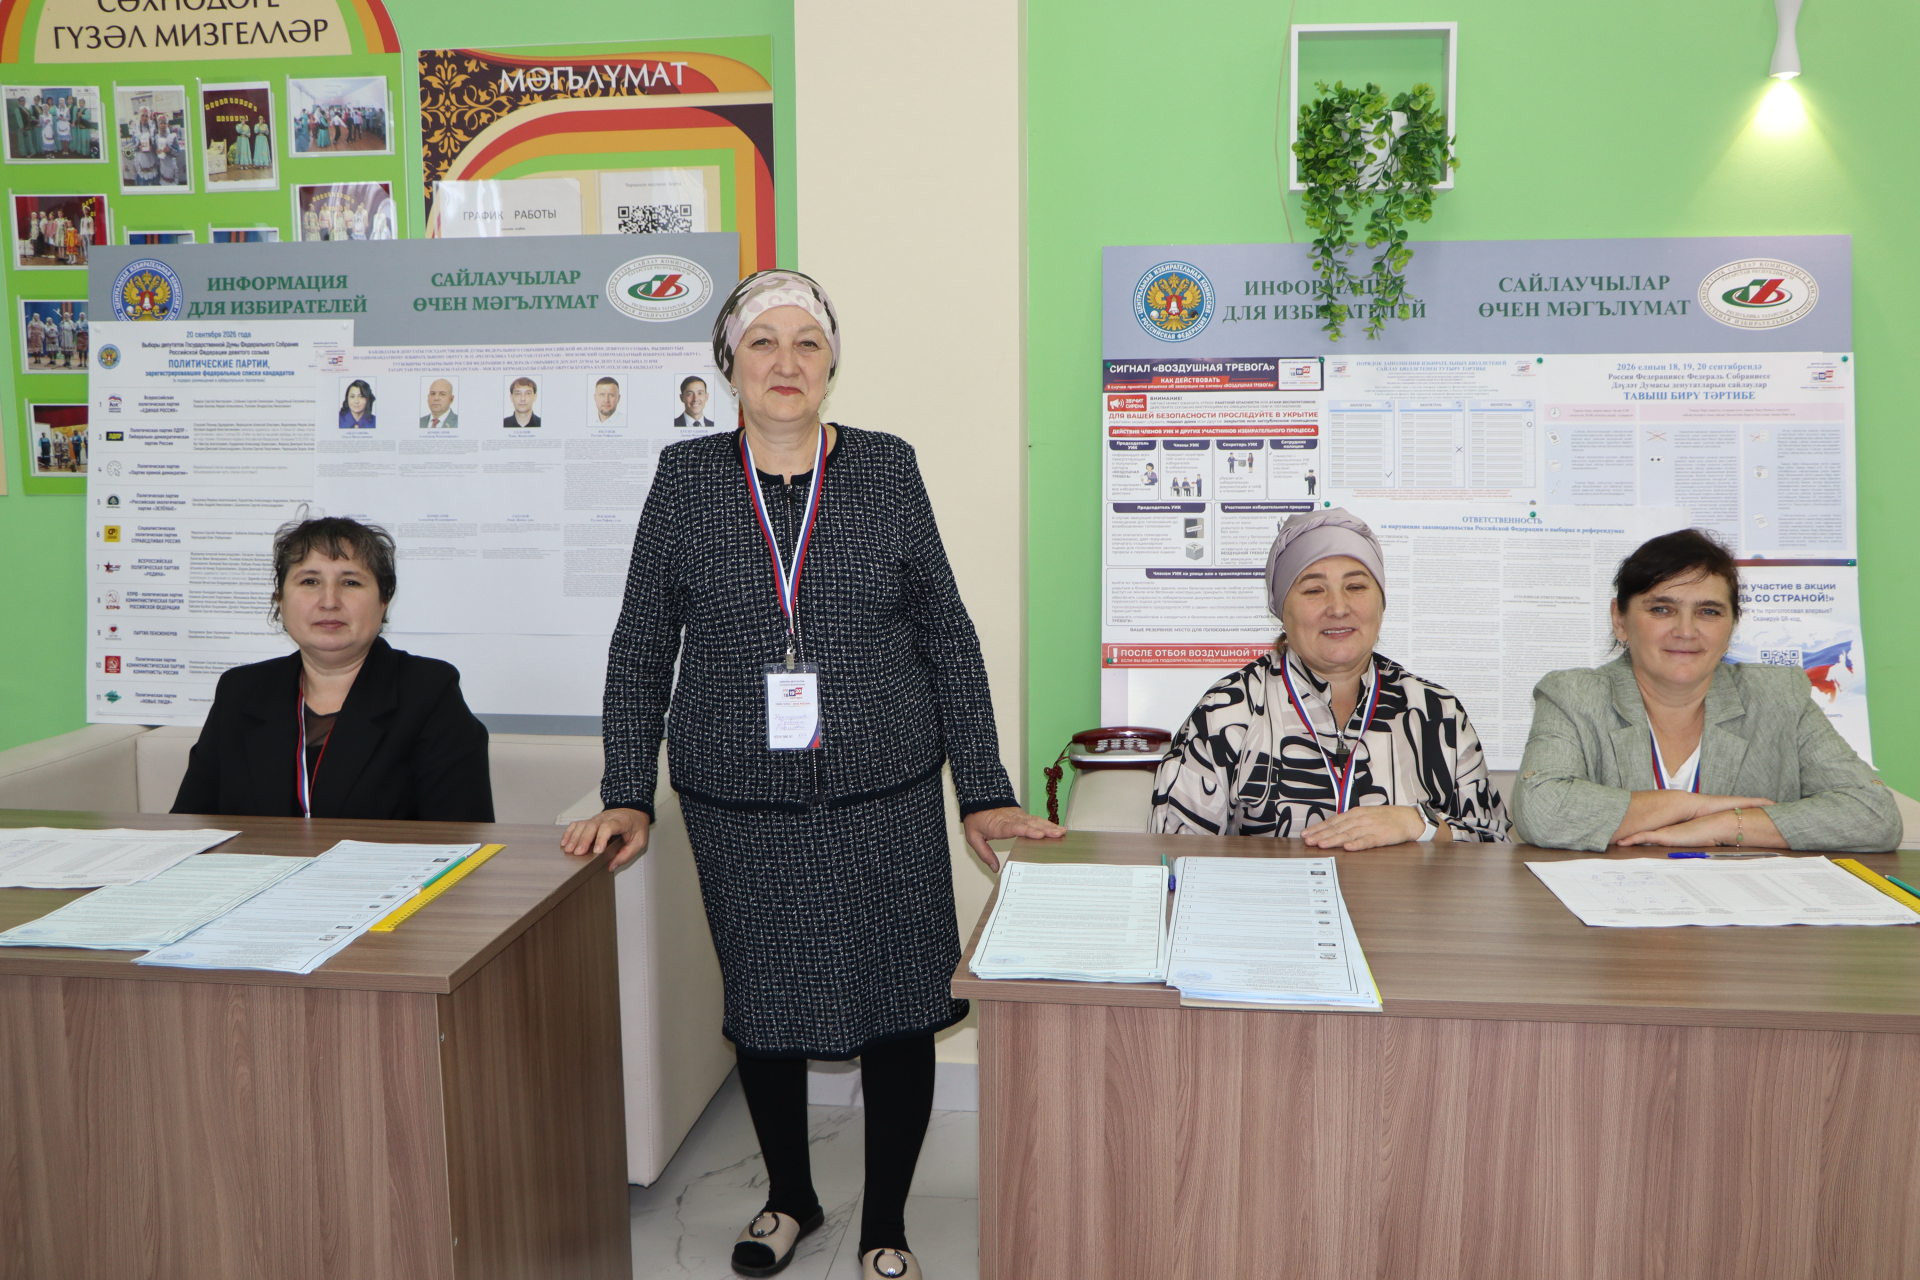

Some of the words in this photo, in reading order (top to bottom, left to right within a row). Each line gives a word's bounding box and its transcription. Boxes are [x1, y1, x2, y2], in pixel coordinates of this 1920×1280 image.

[54, 24, 147, 49] ГҮЗӘЛ
[155, 18, 329, 48] МИЗГЕЛЛӘР
[500, 61, 688, 93] МӘГЪЛҮМАТ
[464, 211, 504, 221] ГРАФИК
[514, 209, 557, 220] РАБОТЫ
[431, 268, 581, 287] САЙЛАУЧЫЛАР
[1499, 273, 1670, 293] САЙЛАУЧЫЛАР
[208, 275, 348, 292] ИНФОРМАЦИЯ
[1136, 273, 1154, 314] ЦЕНТРАЛЬНАЯ
[1154, 264, 1202, 280] ИЗБИРАТЕЛЬНАЯ
[1200, 279, 1212, 314] КОМИССИЯ
[1244, 279, 1404, 297] ИНФОРАЦ
[188, 300, 226, 319] ДЛЯ
[230, 294, 368, 315] ИЗБИРАТЕЛЕЙ
[413, 296, 470, 312] ӨЧЕН
[473, 294, 599, 311] МӘГЪЛҮМАТ
[1222, 304, 1266, 324] ДЛЯ
[1479, 302, 1541, 318] ӨЧЕН
[1547, 300, 1691, 317] МӘГЪЛҮМАТ
[1141, 317, 1176, 339] РОССИЙСКАЯ
[1177, 317, 1207, 339] ФЕДЕРАЦИЯ
[195, 331, 221, 339] сентября
[185, 341, 225, 349] Государственной
[241, 341, 275, 349] Федерального
[168, 359, 233, 368] ПОЛИТИЧЕСКИЕ
[236, 359, 270, 369] ПАРТИИ,
[1110, 364, 1150, 373] СИГНАЛ
[1152, 364, 1223, 374] «ВОЗДУШНАЯ
[1225, 363, 1275, 372] ТРЕВОГА»
[1617, 363, 1636, 371] 2026
[1669, 363, 1680, 372] 18,
[1683, 363, 1695, 371] 19,
[1709, 363, 1762, 372] сентябрендә
[1635, 373, 1685, 381] Федерациясе
[1726, 372, 1771, 380] Собраниесе
[1728, 381, 1768, 389] сайлаулар
[1623, 392, 1668, 400] ТАВЫШ
[1670, 392, 1700, 400] БИРҮ
[1703, 391, 1756, 400] ТӘРТИБЕ
[1127, 411, 1154, 419] ВАШЕЙ
[1220, 411, 1275, 419] ПРОСЛЕДУЙТЕ
[1462, 515, 1543, 524] ОТВЕТСТВЕННОСТЬ
[1751, 583, 1794, 592] участие
[1804, 584, 1836, 592] акции
[1755, 594, 1771, 602] СО
[1773, 592, 1835, 603] СТРАНОЙ!»
[1121, 649, 1152, 657] ПОСЛЕ
[1155, 649, 1186, 657] ОТБОЯ
[1190, 648, 1250, 658] ВОЗДУШНОЙ
[1252, 649, 1274, 657] ТРЕ
